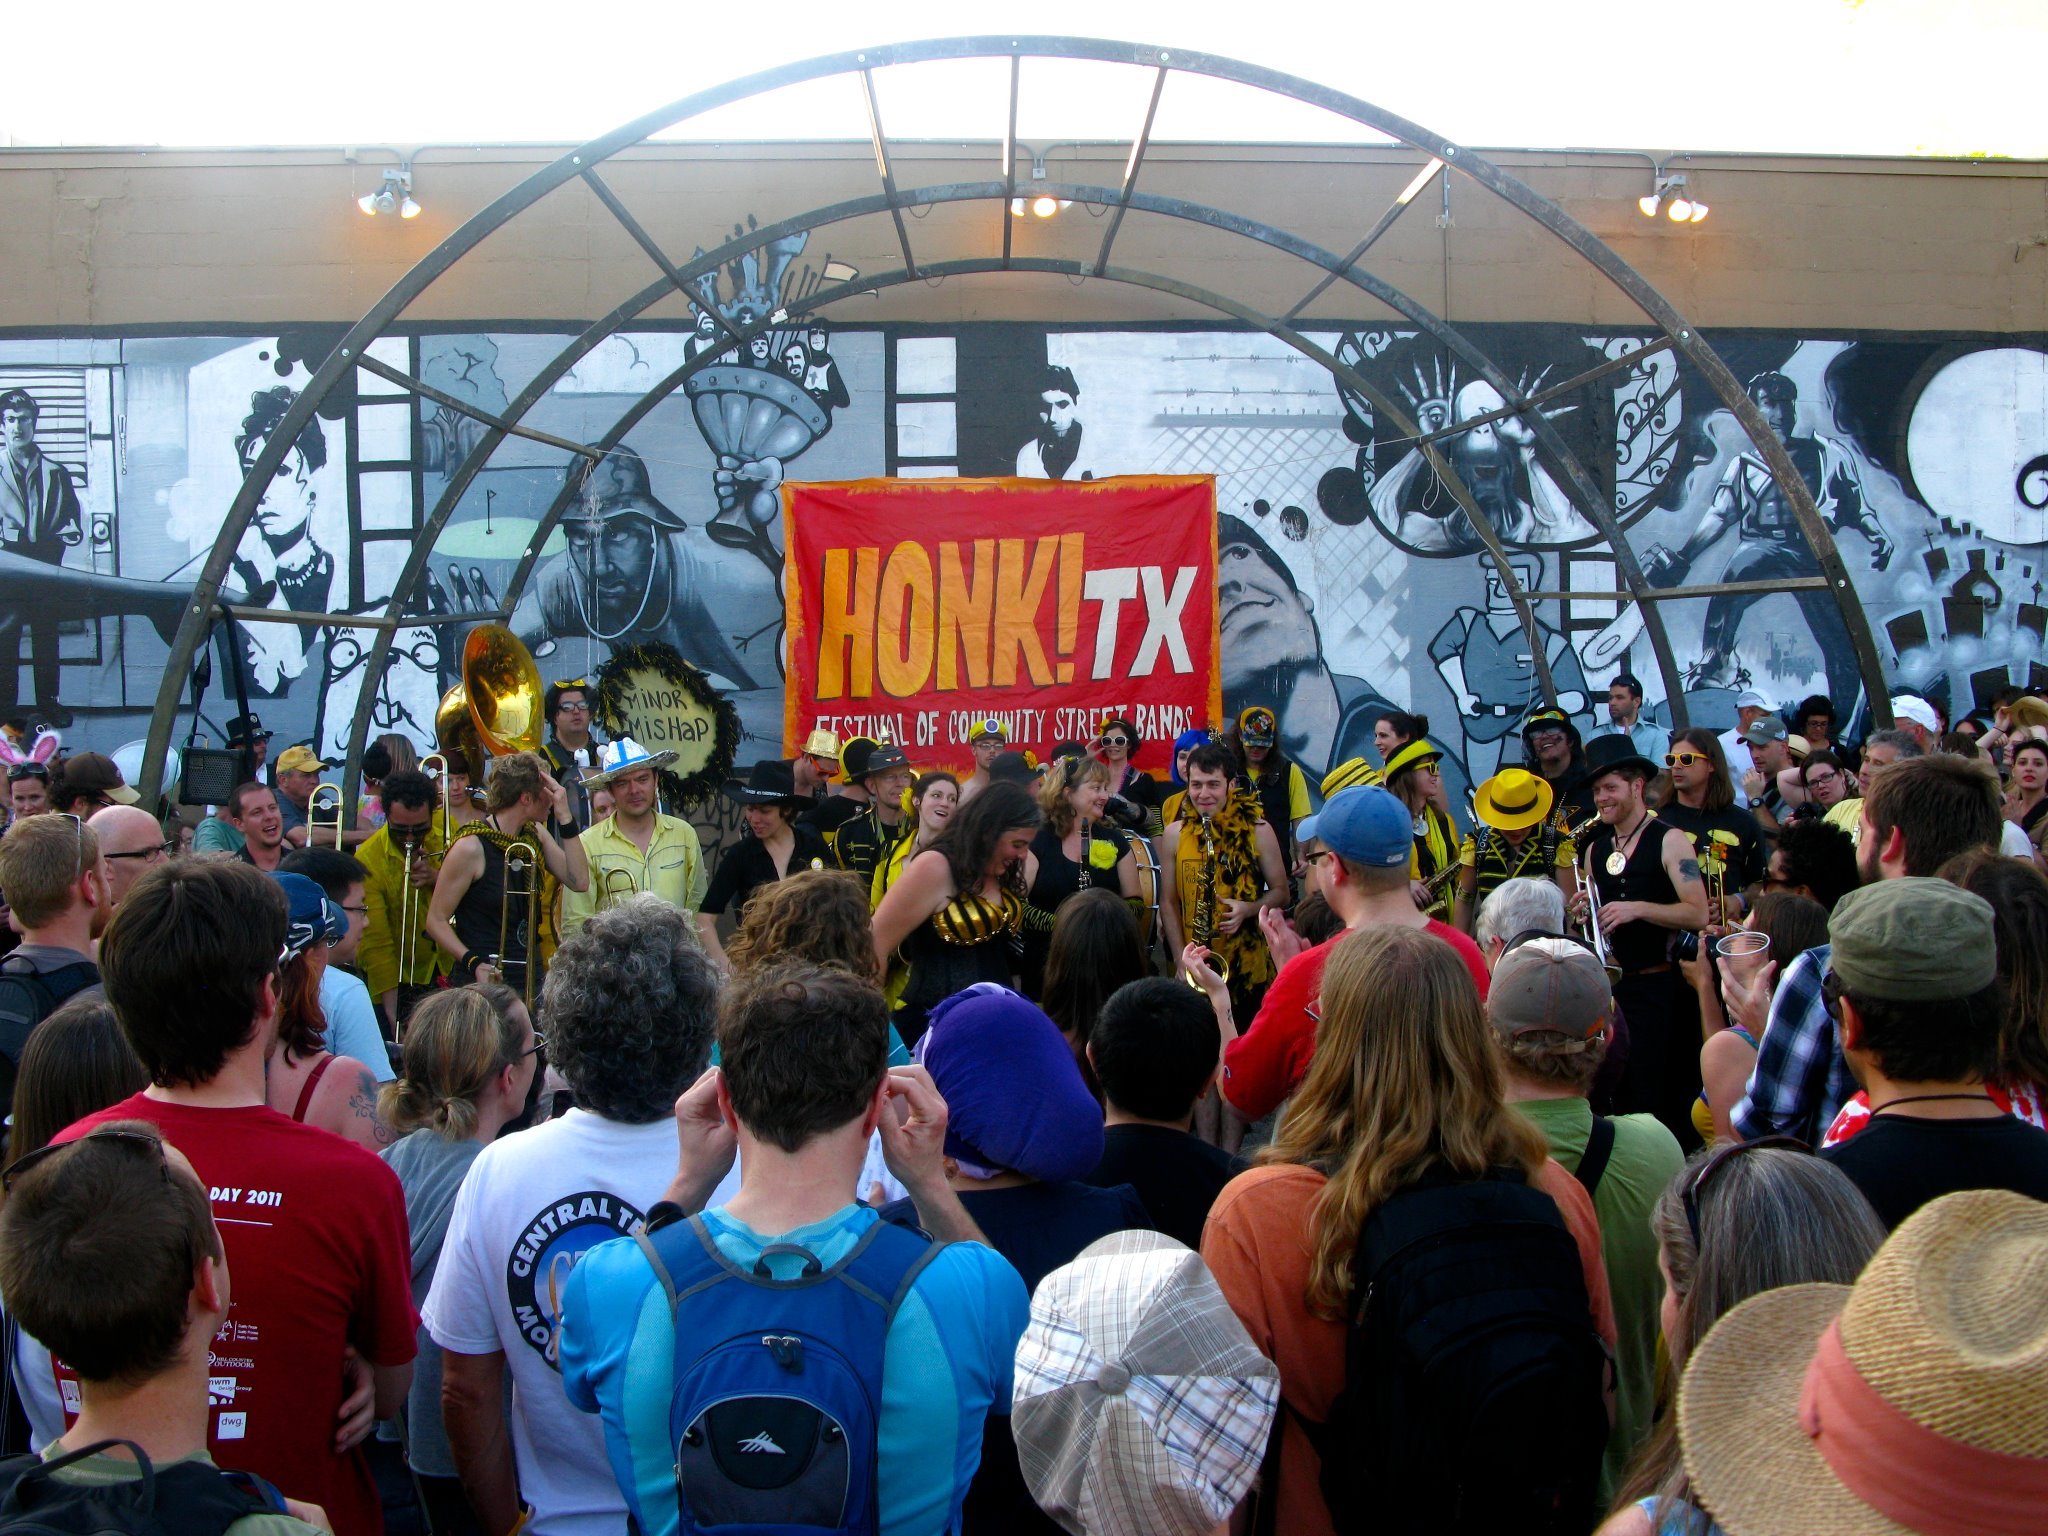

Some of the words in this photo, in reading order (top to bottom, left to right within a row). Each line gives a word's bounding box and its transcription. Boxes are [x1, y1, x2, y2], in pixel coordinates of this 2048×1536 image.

[817, 533, 1085, 699] HONK!
[1084, 566, 1199, 679] TX
[916, 710, 940, 746] OF
[1135, 704, 1193, 741] BANDS
[209, 1186, 242, 1203] DAY
[245, 1189, 283, 1207] 2011
[512, 1197, 611, 1278] CENTRAL
[214, 1361, 255, 1369] OUTDOORS
